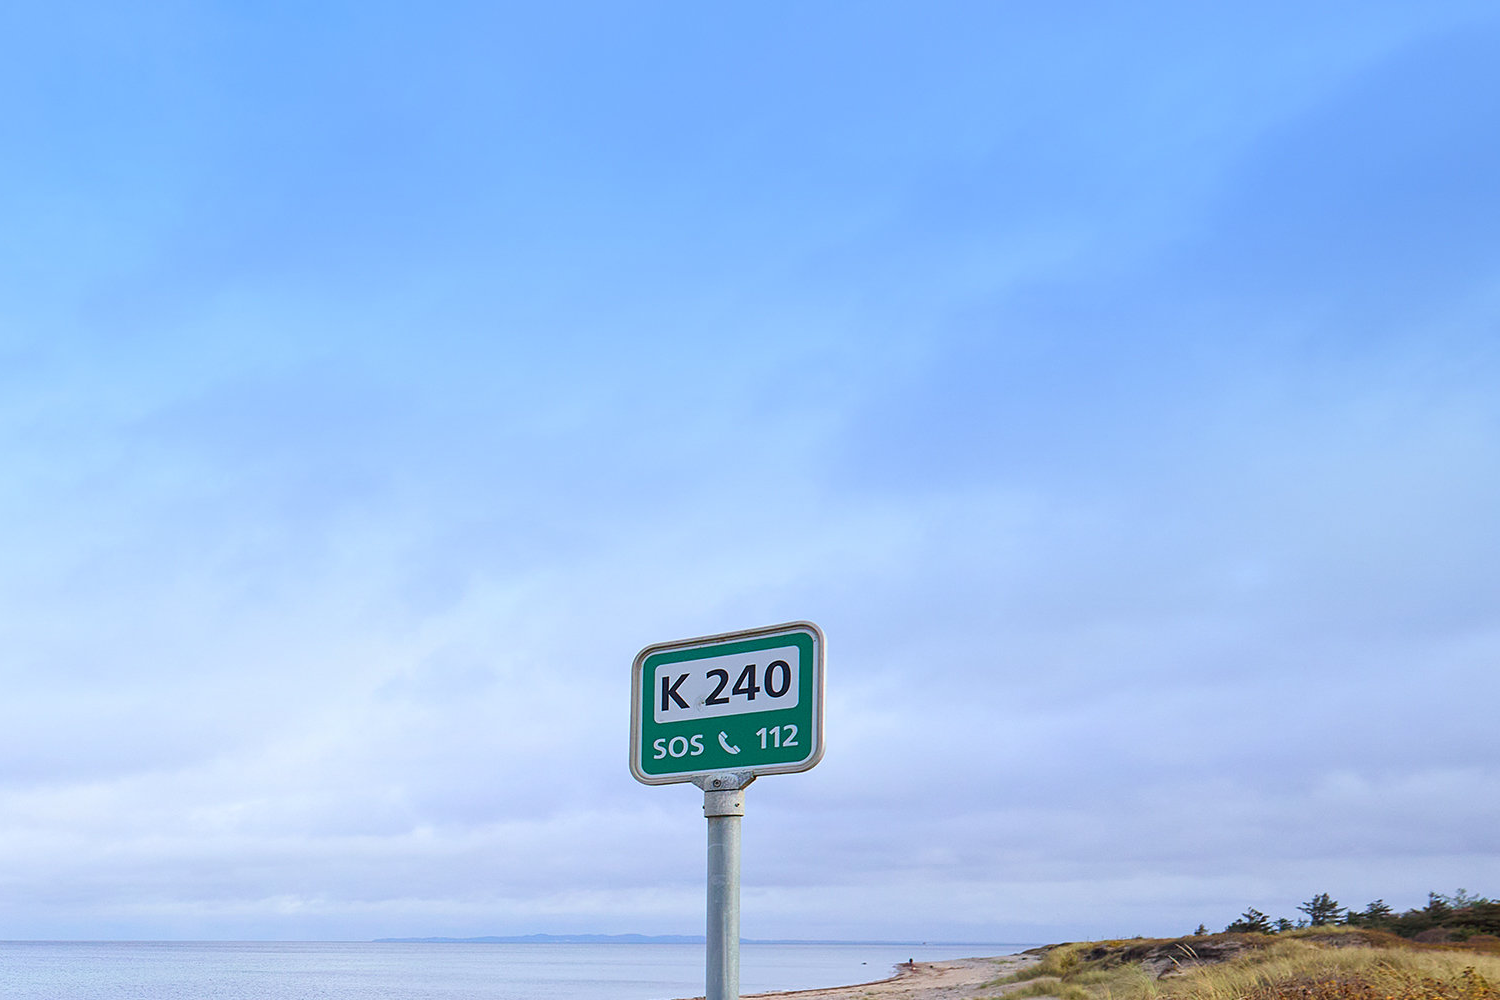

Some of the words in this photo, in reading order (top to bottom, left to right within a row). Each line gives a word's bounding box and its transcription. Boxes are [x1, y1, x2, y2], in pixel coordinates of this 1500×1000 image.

[661, 673, 690, 712] K
[705, 660, 791, 706] 240
[653, 734, 704, 760] SOS
[756, 724, 798, 749] 112
